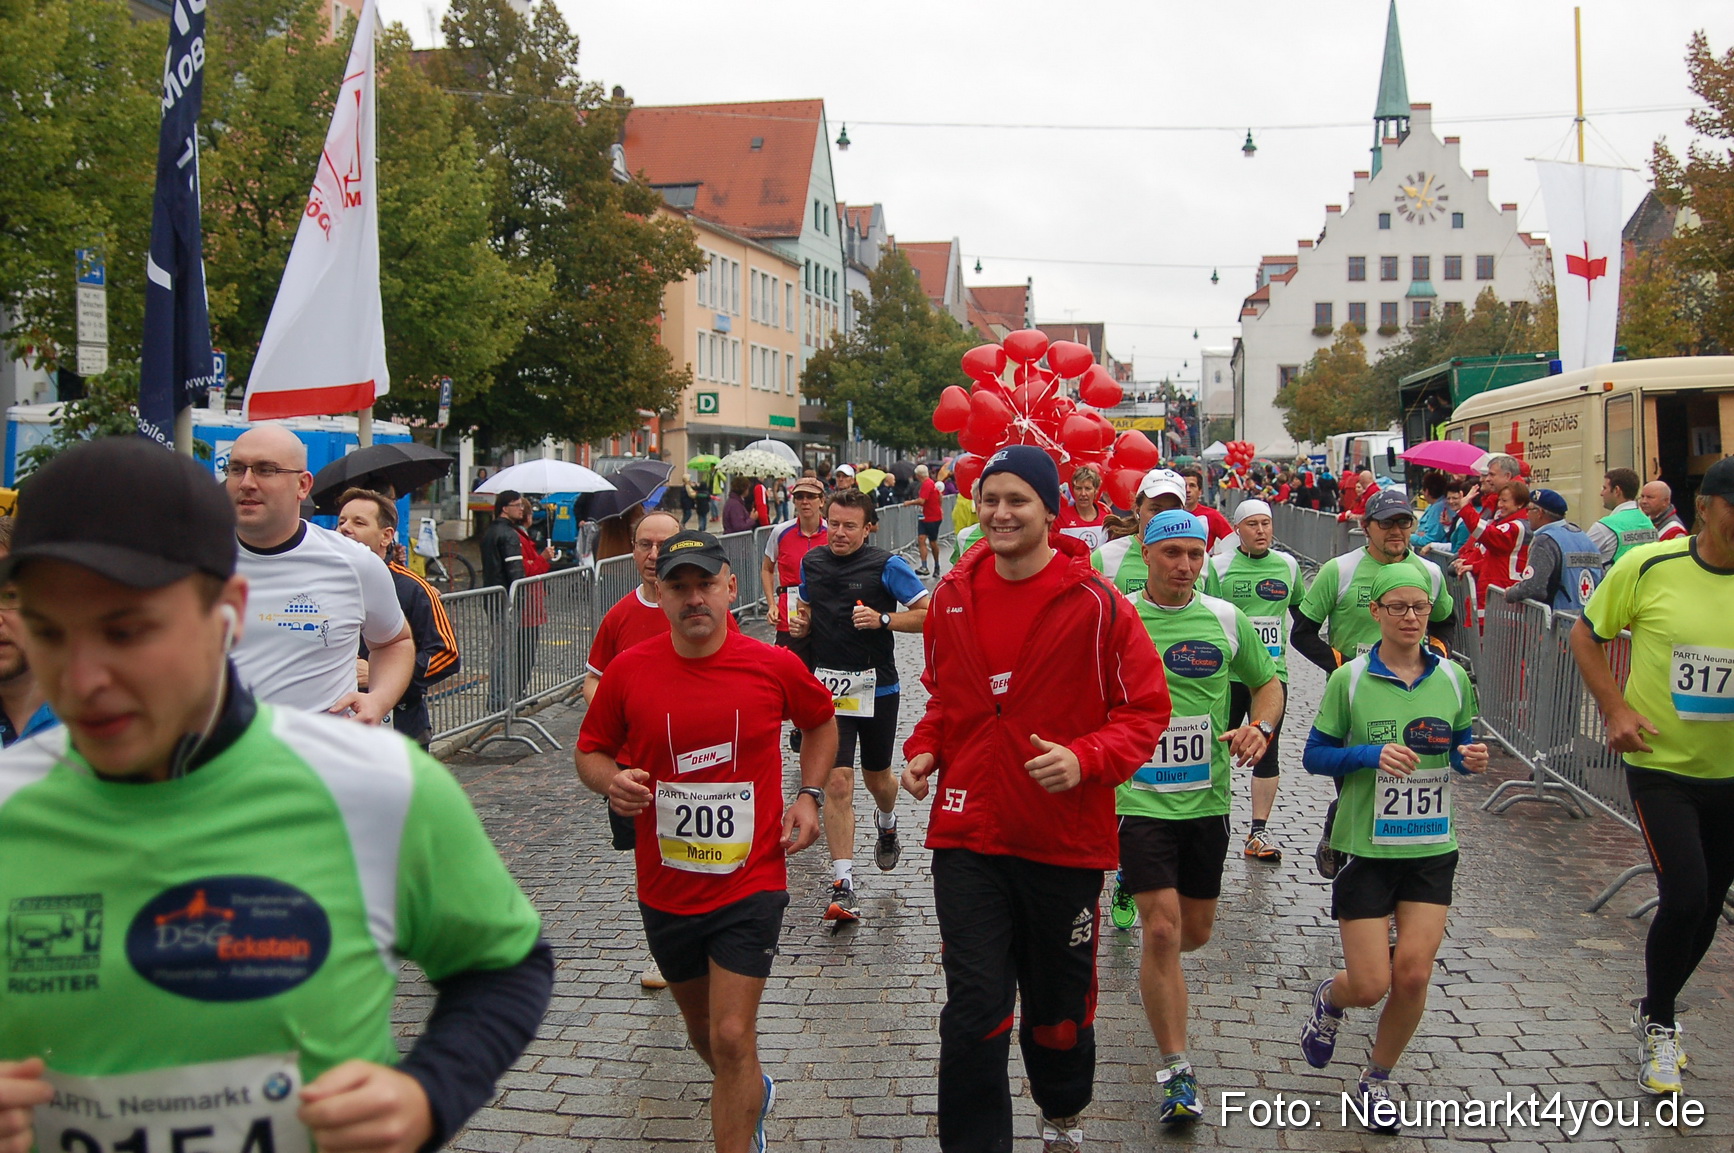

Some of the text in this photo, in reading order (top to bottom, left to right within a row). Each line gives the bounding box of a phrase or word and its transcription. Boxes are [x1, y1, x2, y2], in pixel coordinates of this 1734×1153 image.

[700, 394, 716, 412] D
[1528, 412, 1579, 439] Bayerisches
[1528, 441, 1552, 460] Rotes
[1673, 650, 1734, 664] PARTL Neuma
[1677, 662, 1732, 694] 317
[1163, 723, 1199, 733] eumarkt
[691, 750, 717, 766] DEHN
[1147, 733, 1205, 764] 150
[1155, 770, 1188, 782] Oliver
[1377, 775, 1442, 784] PARTL Neumarkt
[657, 789, 736, 801] PARTL Neumarkt
[942, 787, 968, 813] 53
[1383, 786, 1443, 816] 2151
[674, 804, 735, 839] 208
[1382, 822, 1443, 835] Ann-Christin
[687, 846, 722, 861] Mario
[1068, 922, 1092, 947] 53
[217, 934, 310, 960] Eckstein
[8, 974, 100, 994] RICHTER
[50, 1086, 253, 1119] ARTL Neumarkt
